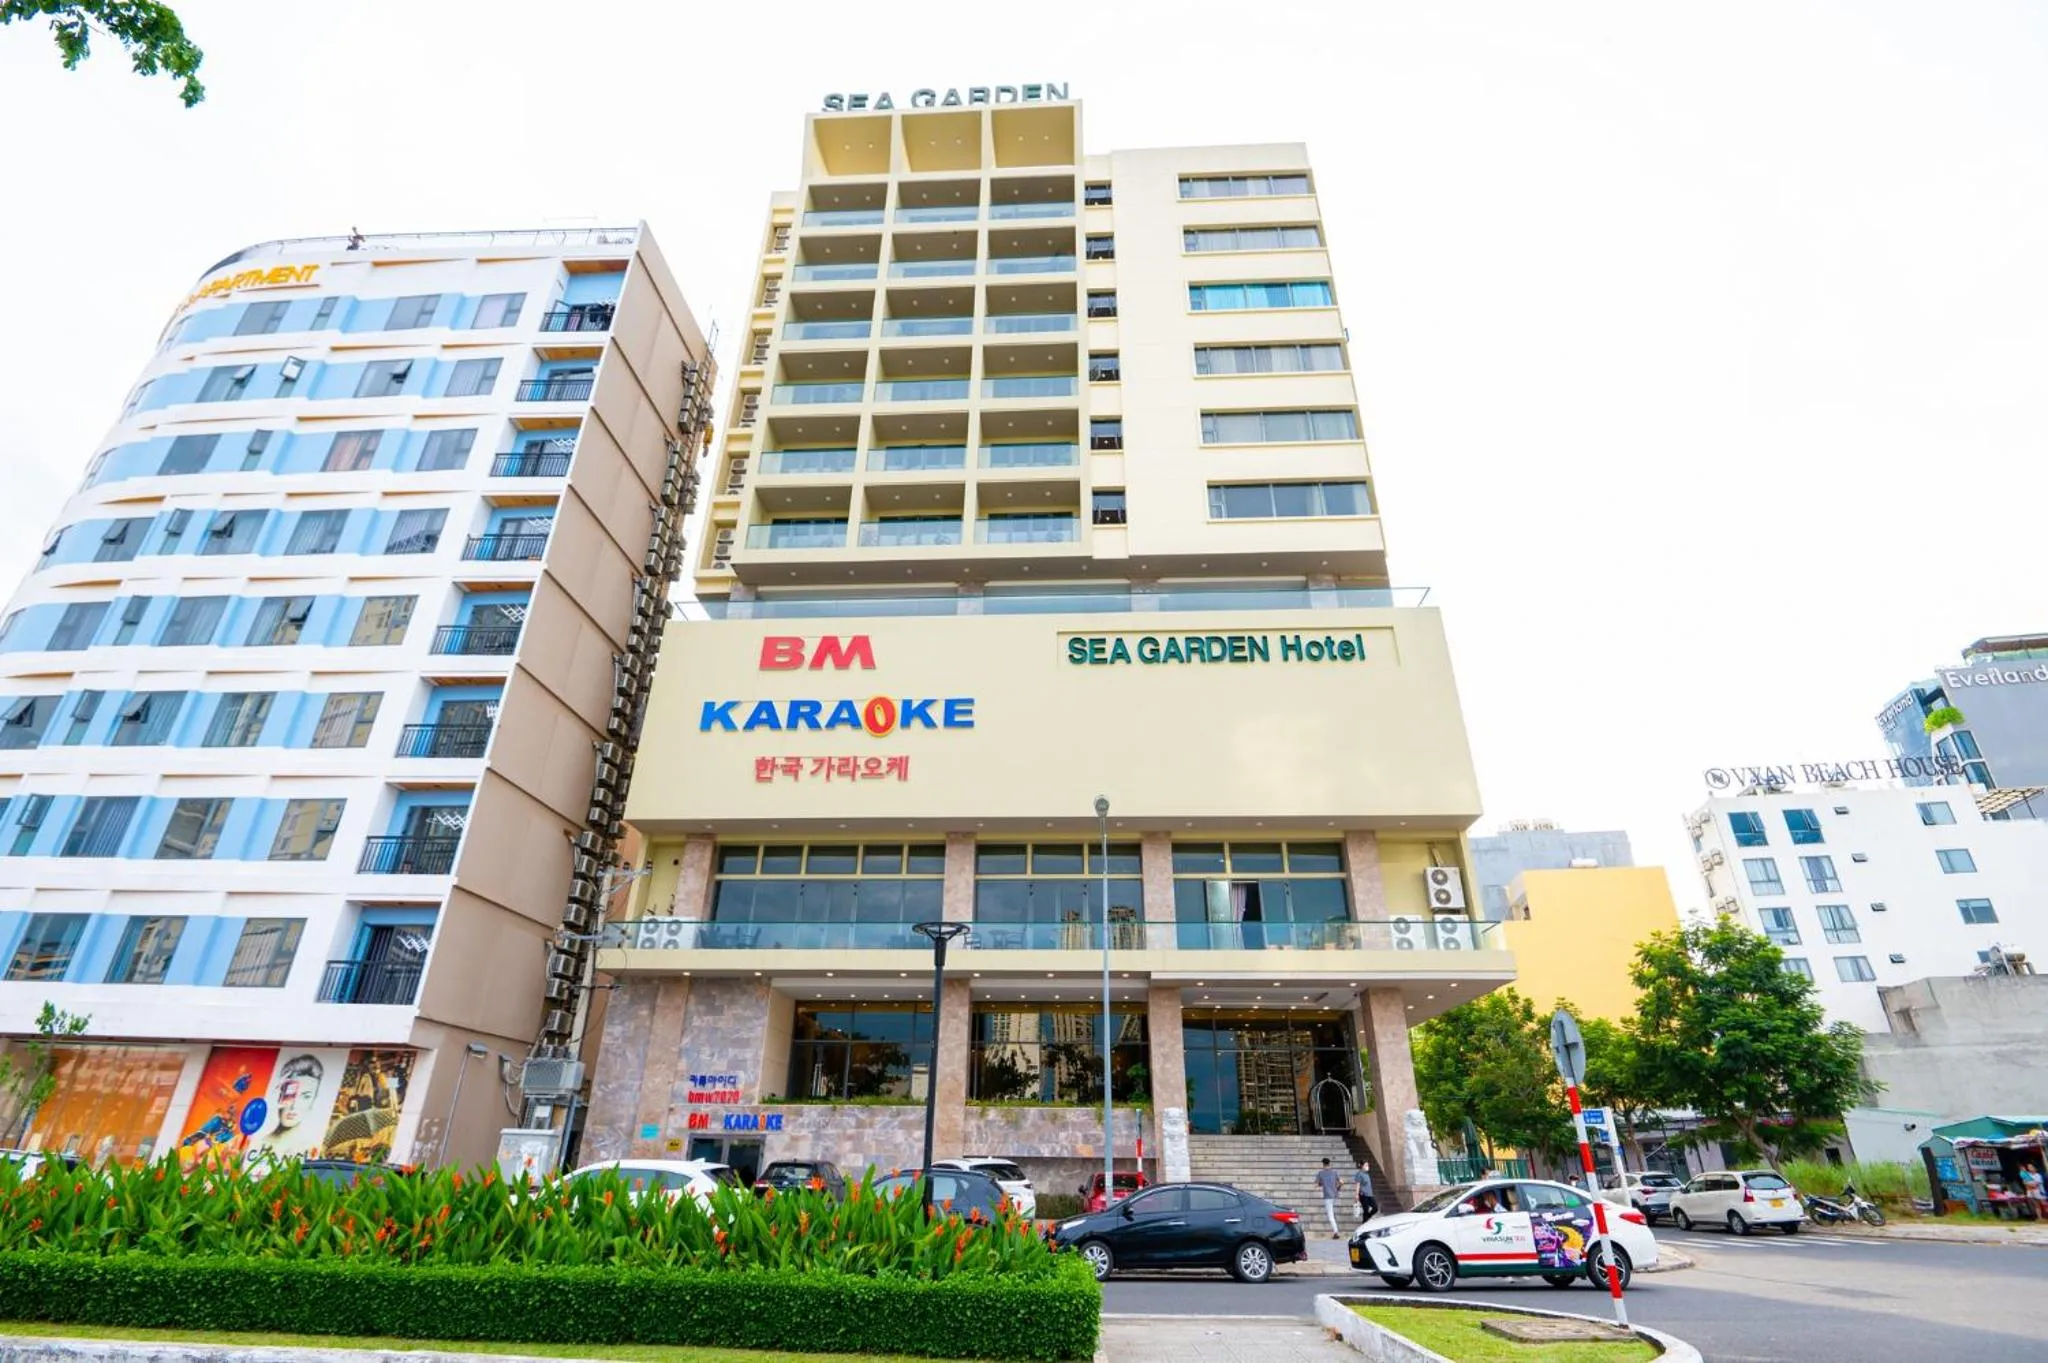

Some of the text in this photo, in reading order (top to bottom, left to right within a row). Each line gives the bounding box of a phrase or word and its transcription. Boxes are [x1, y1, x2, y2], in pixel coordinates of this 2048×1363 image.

[822, 82, 1069, 112] SEA GARDEN
[759, 635, 876, 671] BM
[1068, 633, 1366, 664] SEA GARDEN Hotel
[699, 695, 976, 738] KARAOKE
[754, 755, 910, 782] 한국 가라오케
[1800, 760, 1881, 783] BEACH
[688, 1113, 783, 1131] BM KARAOKE
